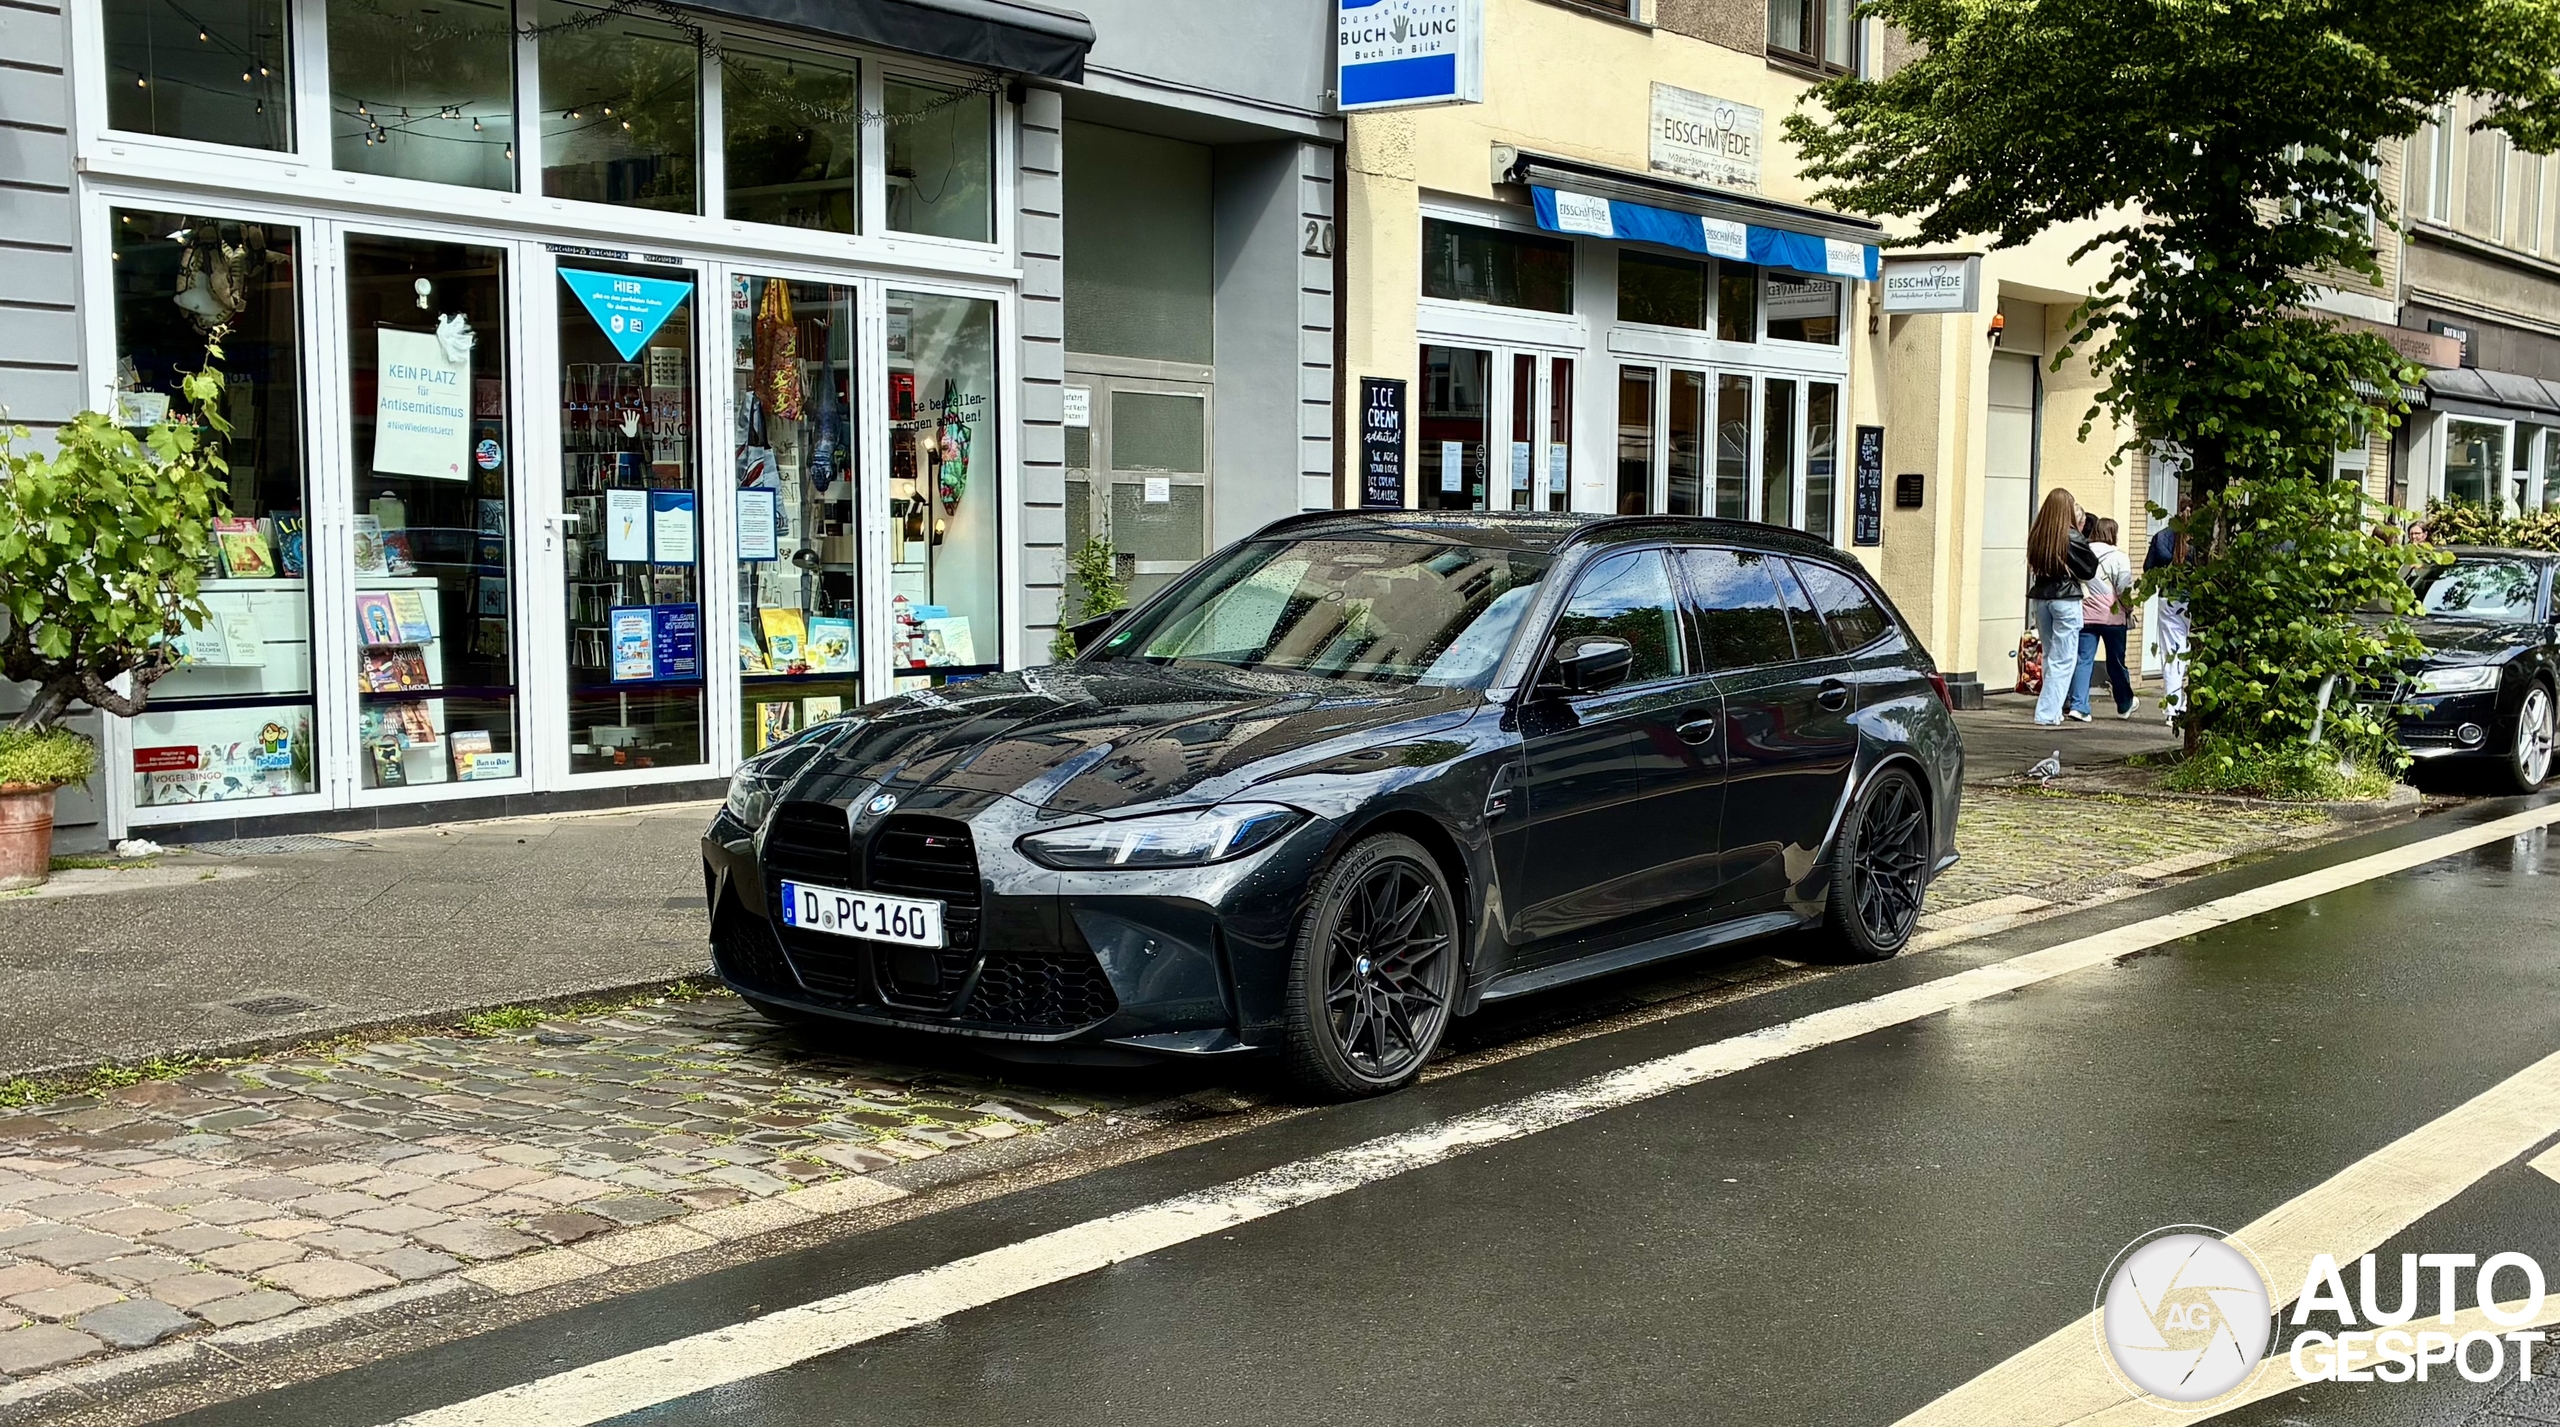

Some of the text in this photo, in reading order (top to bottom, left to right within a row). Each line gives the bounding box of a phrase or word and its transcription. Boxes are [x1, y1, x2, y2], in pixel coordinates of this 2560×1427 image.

[1355, 48, 1384, 60] Buch
[1391, 46, 1403, 56] in
[1305, 220, 1336, 254] 20
[613, 279, 641, 295] HIER
[389, 364, 456, 385] KEIN PLATZ
[417, 385, 429, 396] für
[1371, 386, 1395, 408] ICE
[380, 397, 464, 418] Antisemitismus
[1367, 407, 1399, 429] CREAM
[154, 771, 222, 783] VOGEL-BINGO
[804, 891, 927, 940] D PC 160
